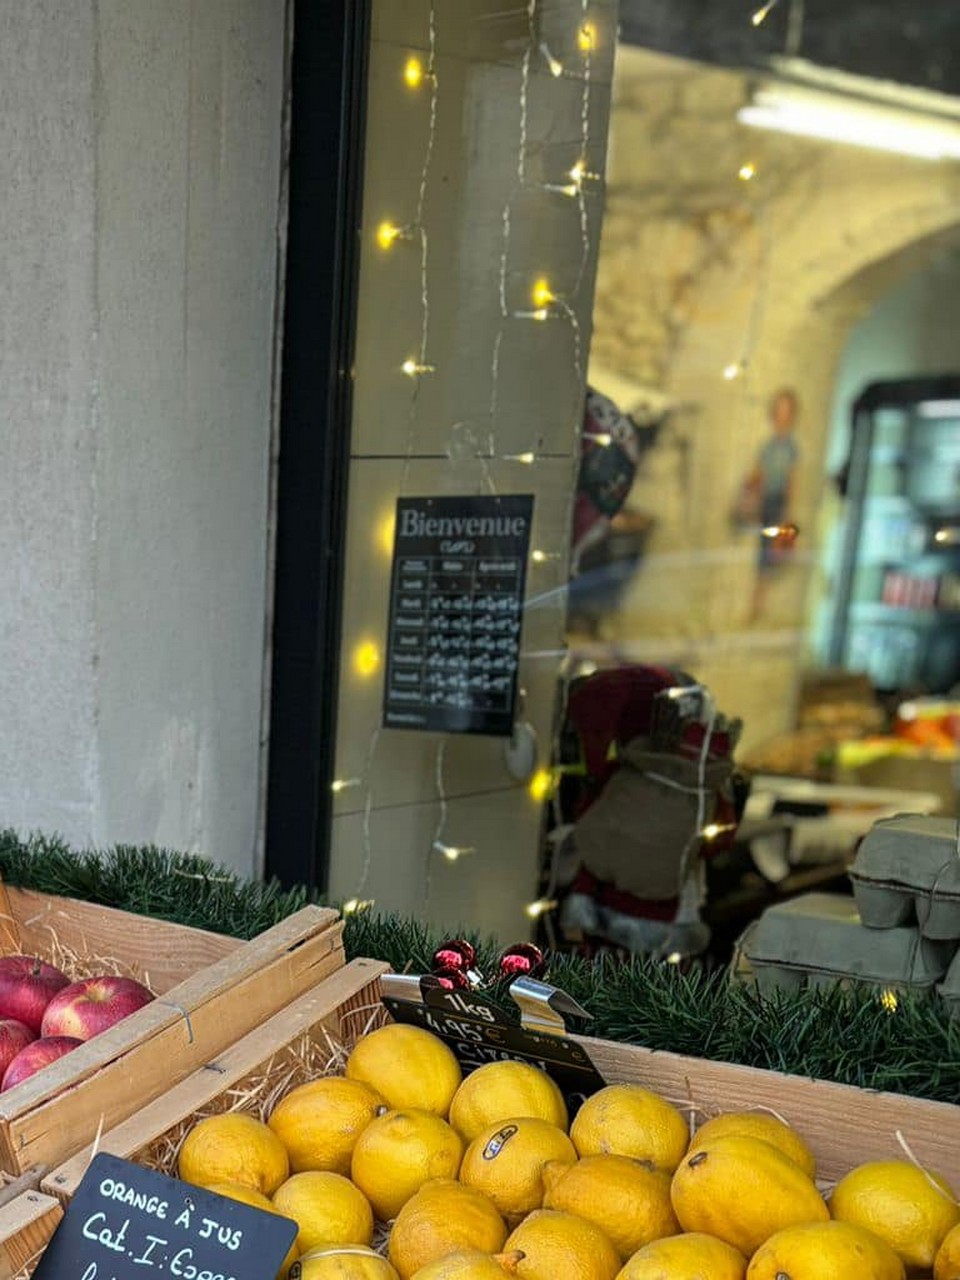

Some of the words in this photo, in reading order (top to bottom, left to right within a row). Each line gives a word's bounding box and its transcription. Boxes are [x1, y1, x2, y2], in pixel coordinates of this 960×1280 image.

[400, 509, 526, 537] Bienvenue
[444, 993, 495, 1022] 1kg
[100, 1179, 168, 1219] ORANGE
[199, 1218, 243, 1250] JUS
